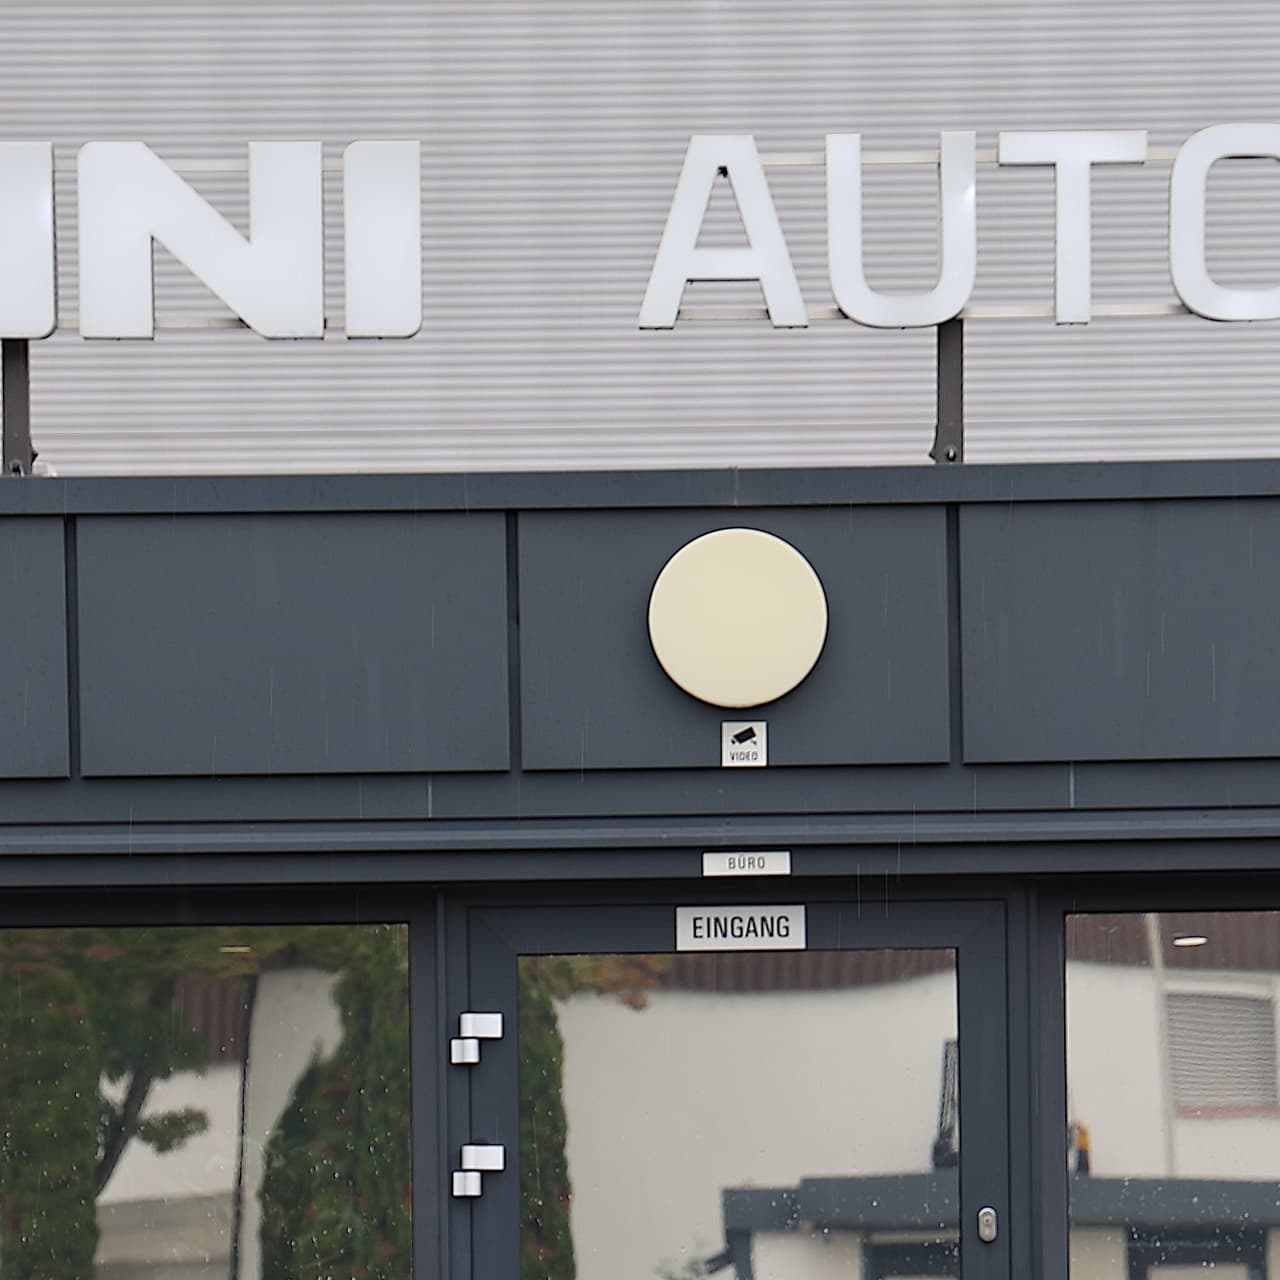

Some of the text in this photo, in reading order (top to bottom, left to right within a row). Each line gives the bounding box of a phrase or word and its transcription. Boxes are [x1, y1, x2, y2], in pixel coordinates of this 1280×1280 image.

[730, 751, 759, 761] VIDEO
[728, 855, 766, 869] BÜRO
[692, 915, 790, 939] EINGANG
